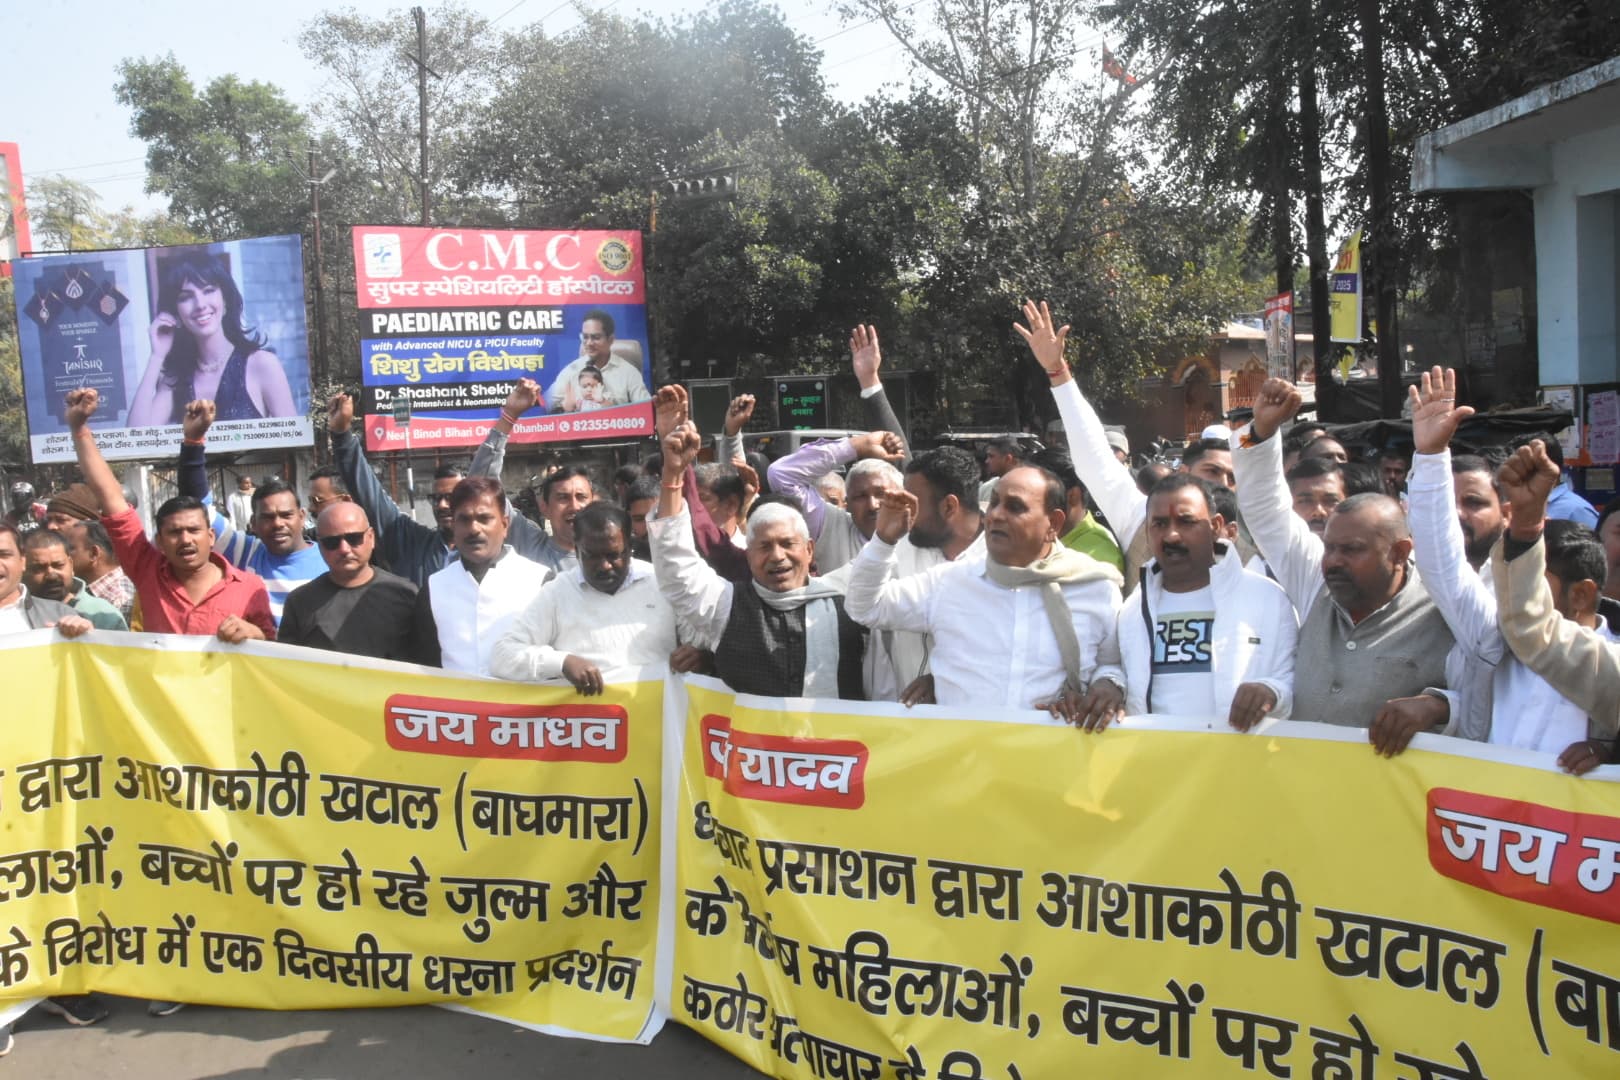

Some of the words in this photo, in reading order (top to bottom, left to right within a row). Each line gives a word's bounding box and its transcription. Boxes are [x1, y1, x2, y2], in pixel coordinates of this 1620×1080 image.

[425, 233, 581, 271] C.M.C
[367, 279, 419, 304] सुपर
[424, 275, 542, 296] स्पेशियलिटी
[547, 275, 634, 295] हॉस्पीटल
[372, 311, 500, 333] PAEDIATRIC
[508, 310, 563, 330] CARE
[372, 342, 392, 350] with
[395, 340, 446, 350] Advanced
[447, 340, 473, 348] NICU
[475, 339, 482, 347] &
[484, 338, 508, 347] PICU
[511, 337, 544, 348] Faculty
[370, 353, 421, 382] शिशु
[424, 352, 464, 373] रोग
[375, 388, 394, 400] Dr.
[398, 385, 468, 399] Shashank
[413, 399, 453, 408] Intensivist
[464, 398, 507, 407] Neonatolog
[414, 427, 442, 439] Binod
[445, 426, 472, 437] Bihari
[513, 421, 554, 433] Dhanbad
[573, 418, 646, 432] 8235540809
[390, 706, 478, 745] जय
[487, 714, 621, 750] माधव
[737, 745, 858, 794] यादव
[16, 755, 103, 813] द्वारा
[114, 751, 310, 817] आशाकोठी
[320, 774, 441, 830] खटाल
[454, 772, 648, 856] (बाघमारा)
[1434, 807, 1567, 885] जय
[138, 840, 239, 895] बच्चों
[243, 860, 306, 906] पर
[314, 848, 362, 912] हो
[372, 855, 430, 917] रहे
[440, 876, 550, 943] जुल्म
[561, 862, 648, 922] और
[756, 839, 917, 905] प्रसाशन
[927, 858, 1024, 921] द्वारा
[1036, 868, 1301, 960] आशाकोठी
[1315, 907, 1506, 1009] खटाल
[43, 910, 147, 976] विरोध
[156, 912, 196, 967] में
[201, 931, 265, 973] एक
[273, 928, 413, 992] दिवसीय
[422, 954, 516, 997] धरना
[524, 939, 642, 1001] प्रदर्शन
[685, 874, 734, 936] के
[808, 930, 1041, 1040] महिलाओं,
[1060, 978, 1205, 1060] बच्चों
[1212, 1007, 1299, 1079] पर
[684, 971, 768, 1040] कठोर
